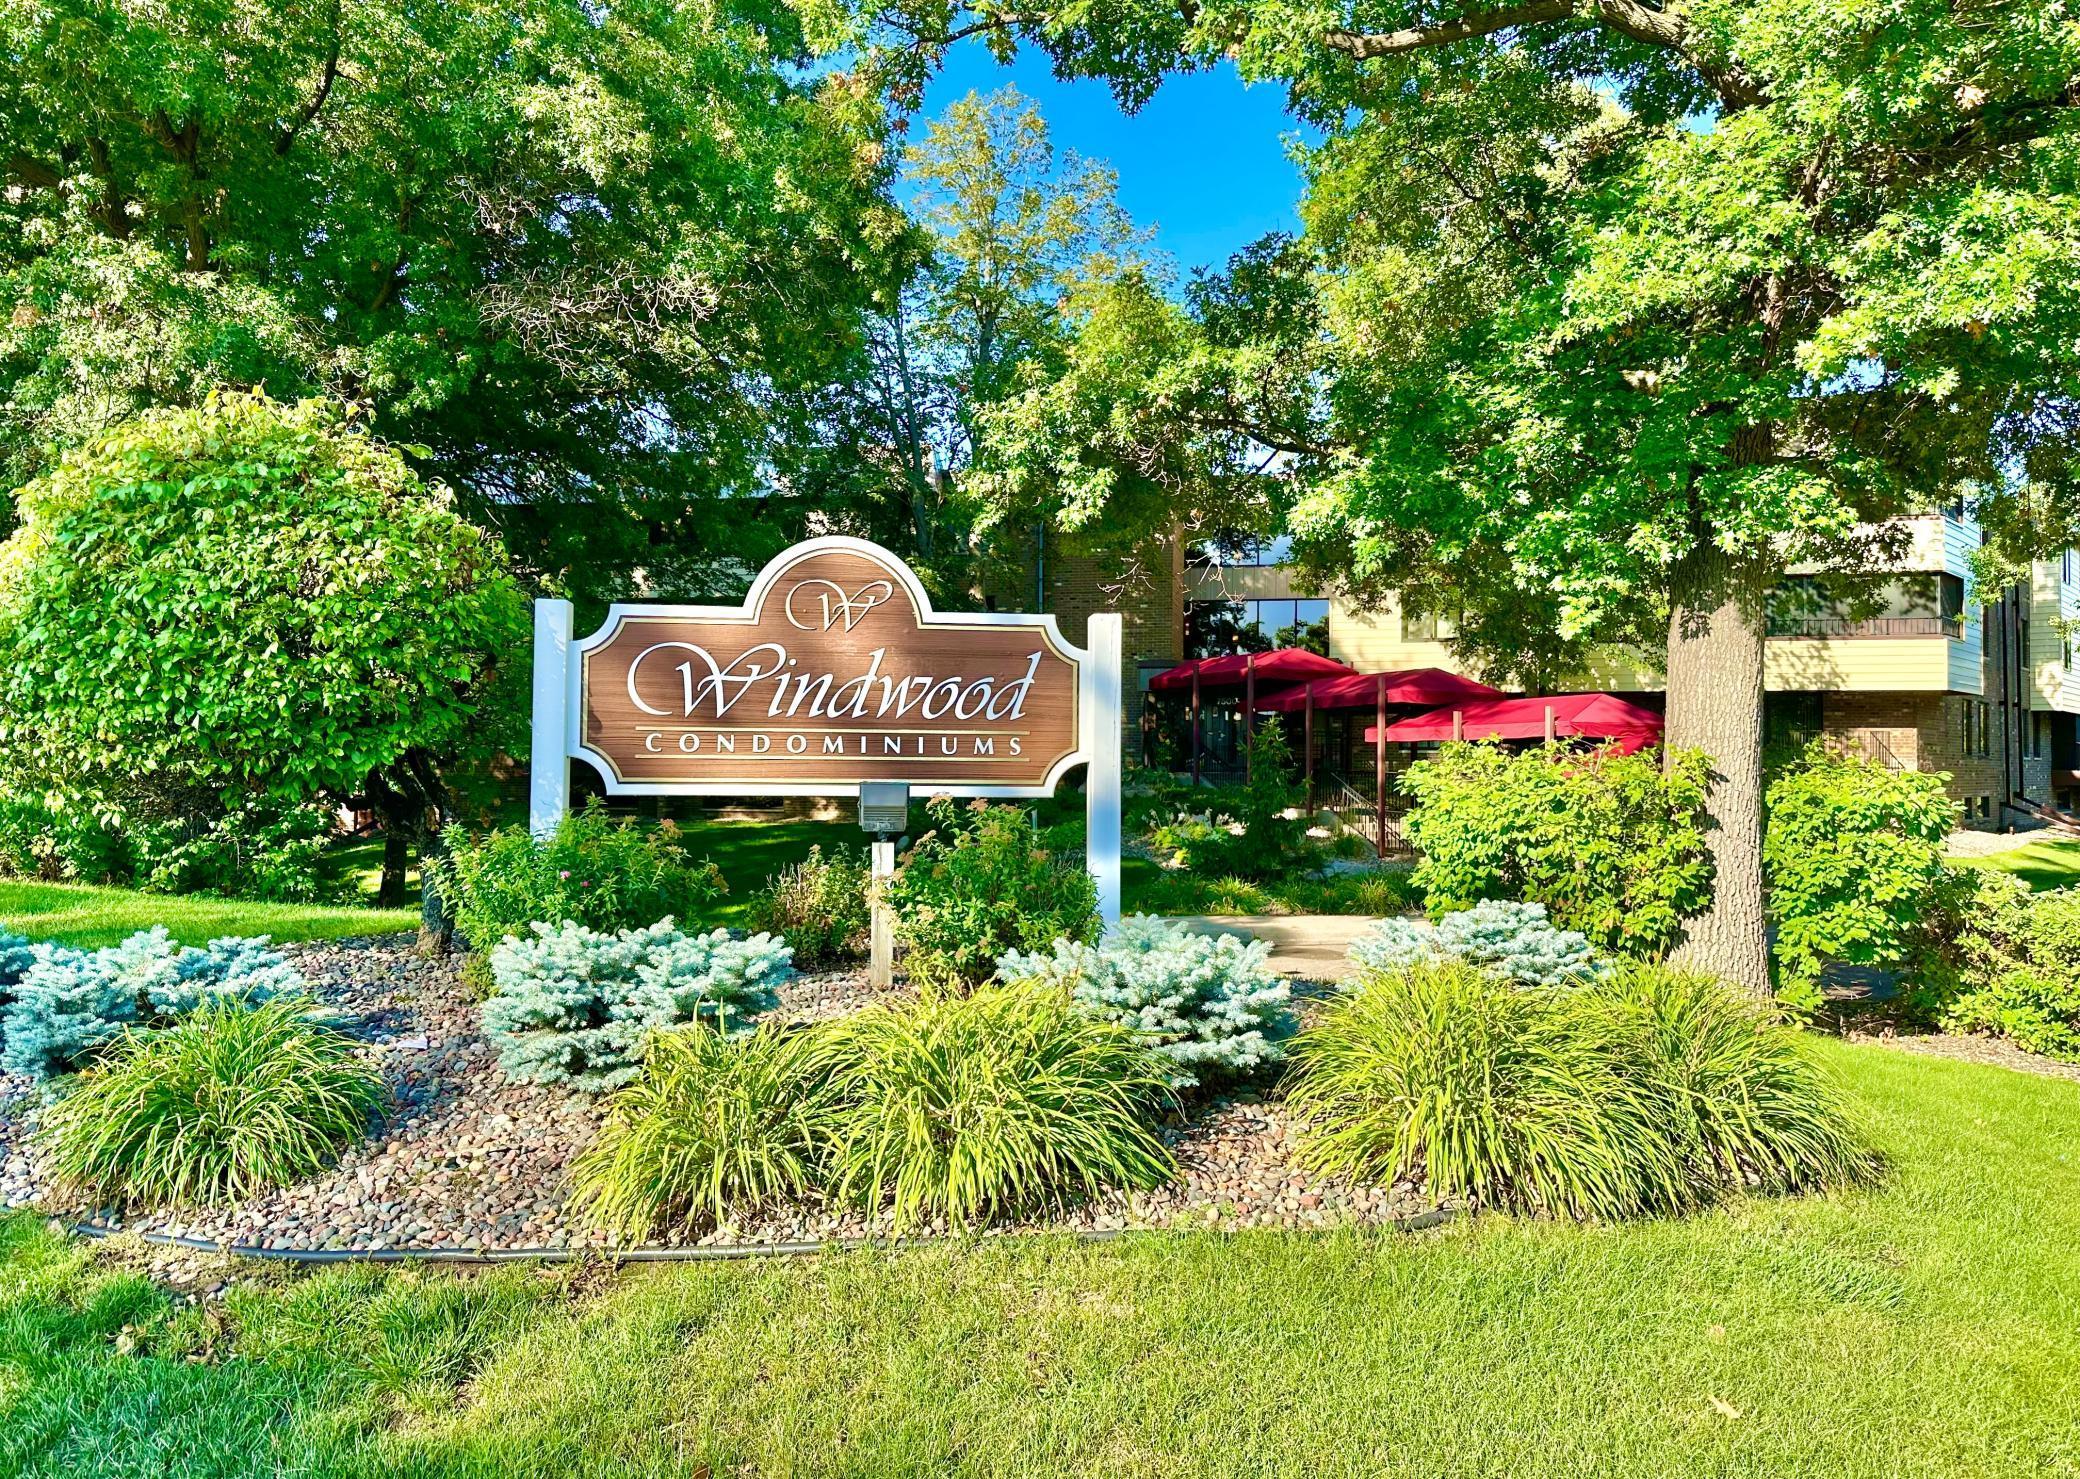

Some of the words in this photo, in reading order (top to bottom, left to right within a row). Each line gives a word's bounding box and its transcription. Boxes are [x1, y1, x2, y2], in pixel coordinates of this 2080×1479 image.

[785, 579, 894, 633] W
[627, 642, 1042, 720] Windwood
[645, 732, 1022, 757] CONDOMINIUMS
